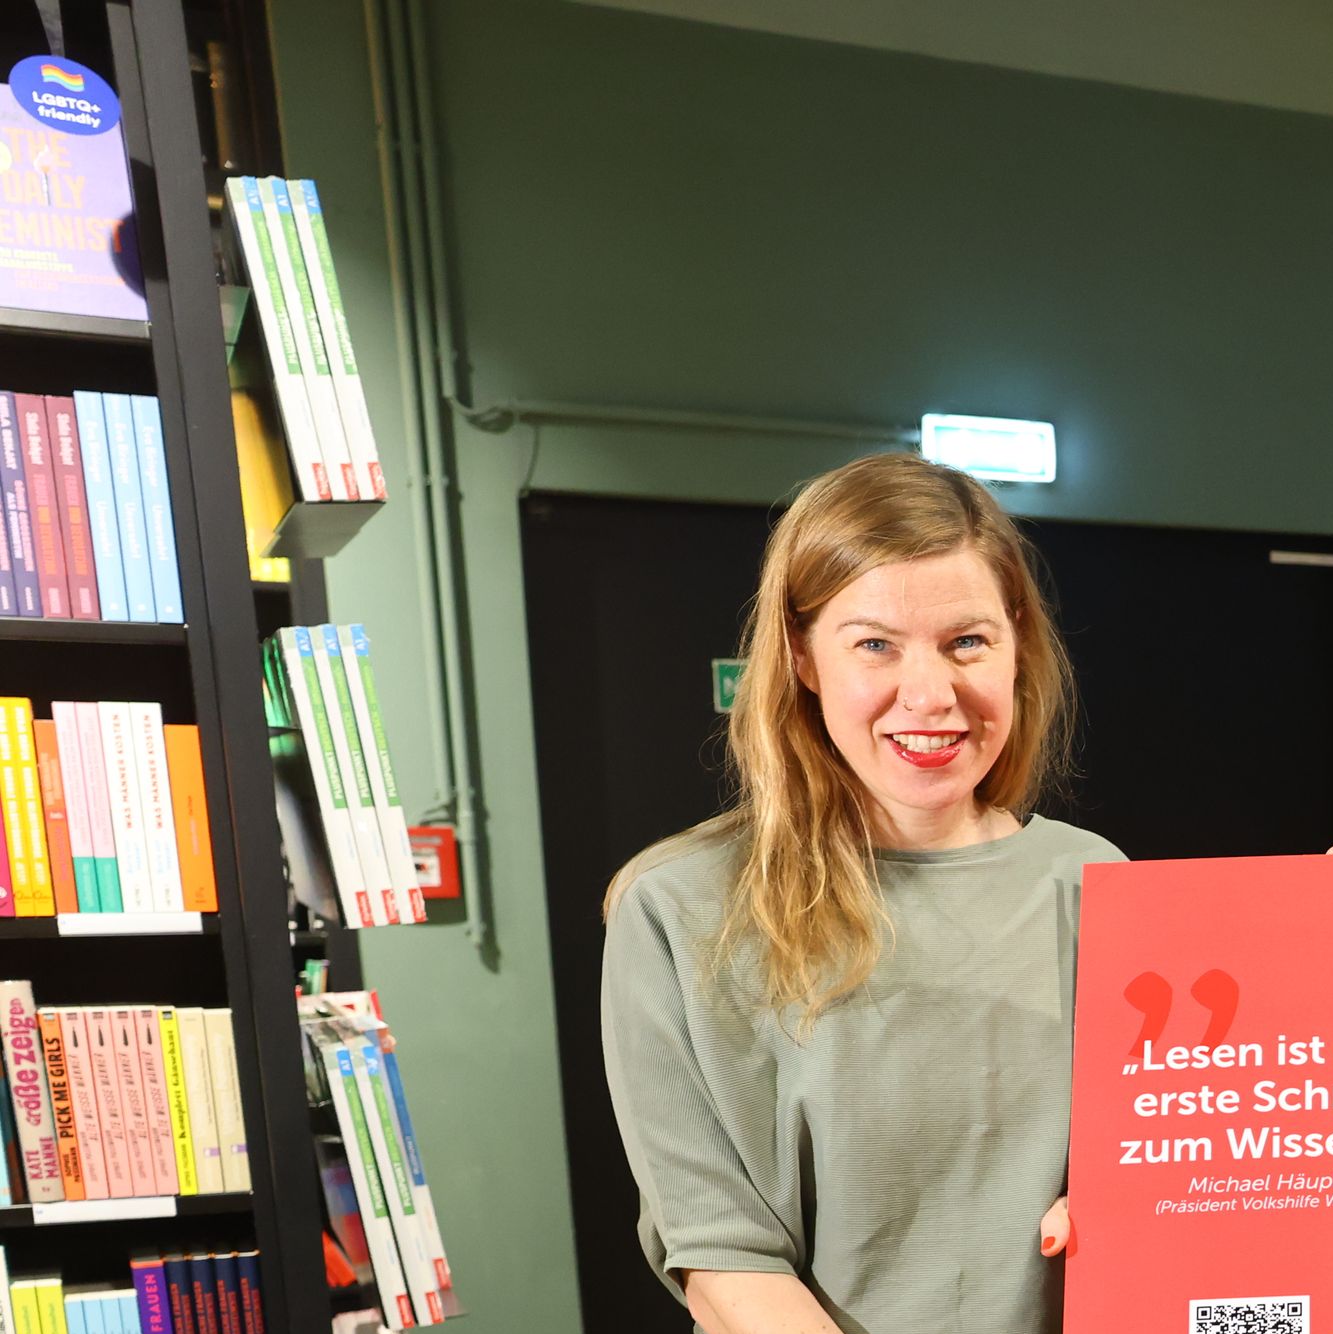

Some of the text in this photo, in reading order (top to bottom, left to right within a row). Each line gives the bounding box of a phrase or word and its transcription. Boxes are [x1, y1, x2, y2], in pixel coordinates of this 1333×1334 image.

[32, 91, 102, 114] LGBTQ+
[38, 105, 101, 128] friendly
[4, 127, 72, 168] THE
[2, 170, 85, 209] DAILY
[0, 209, 124, 253] EMINIST
[4, 997, 39, 1066] zeigen
[1122, 1039, 1263, 1075] „Lesen
[1277, 1035, 1324, 1065] ist
[45, 1037, 74, 1139] PICK ME GIRLS
[1134, 1085, 1240, 1116] erste
[26, 1150, 44, 1181] KATE
[39, 1137, 59, 1180] MANNE
[1119, 1138, 1212, 1164] zum
[1188, 1175, 1270, 1194] Michael
[1156, 1197, 1236, 1215] (Präsident
[1241, 1194, 1320, 1211] Volkshilfe
[143, 1273, 164, 1333] FRAUEN
